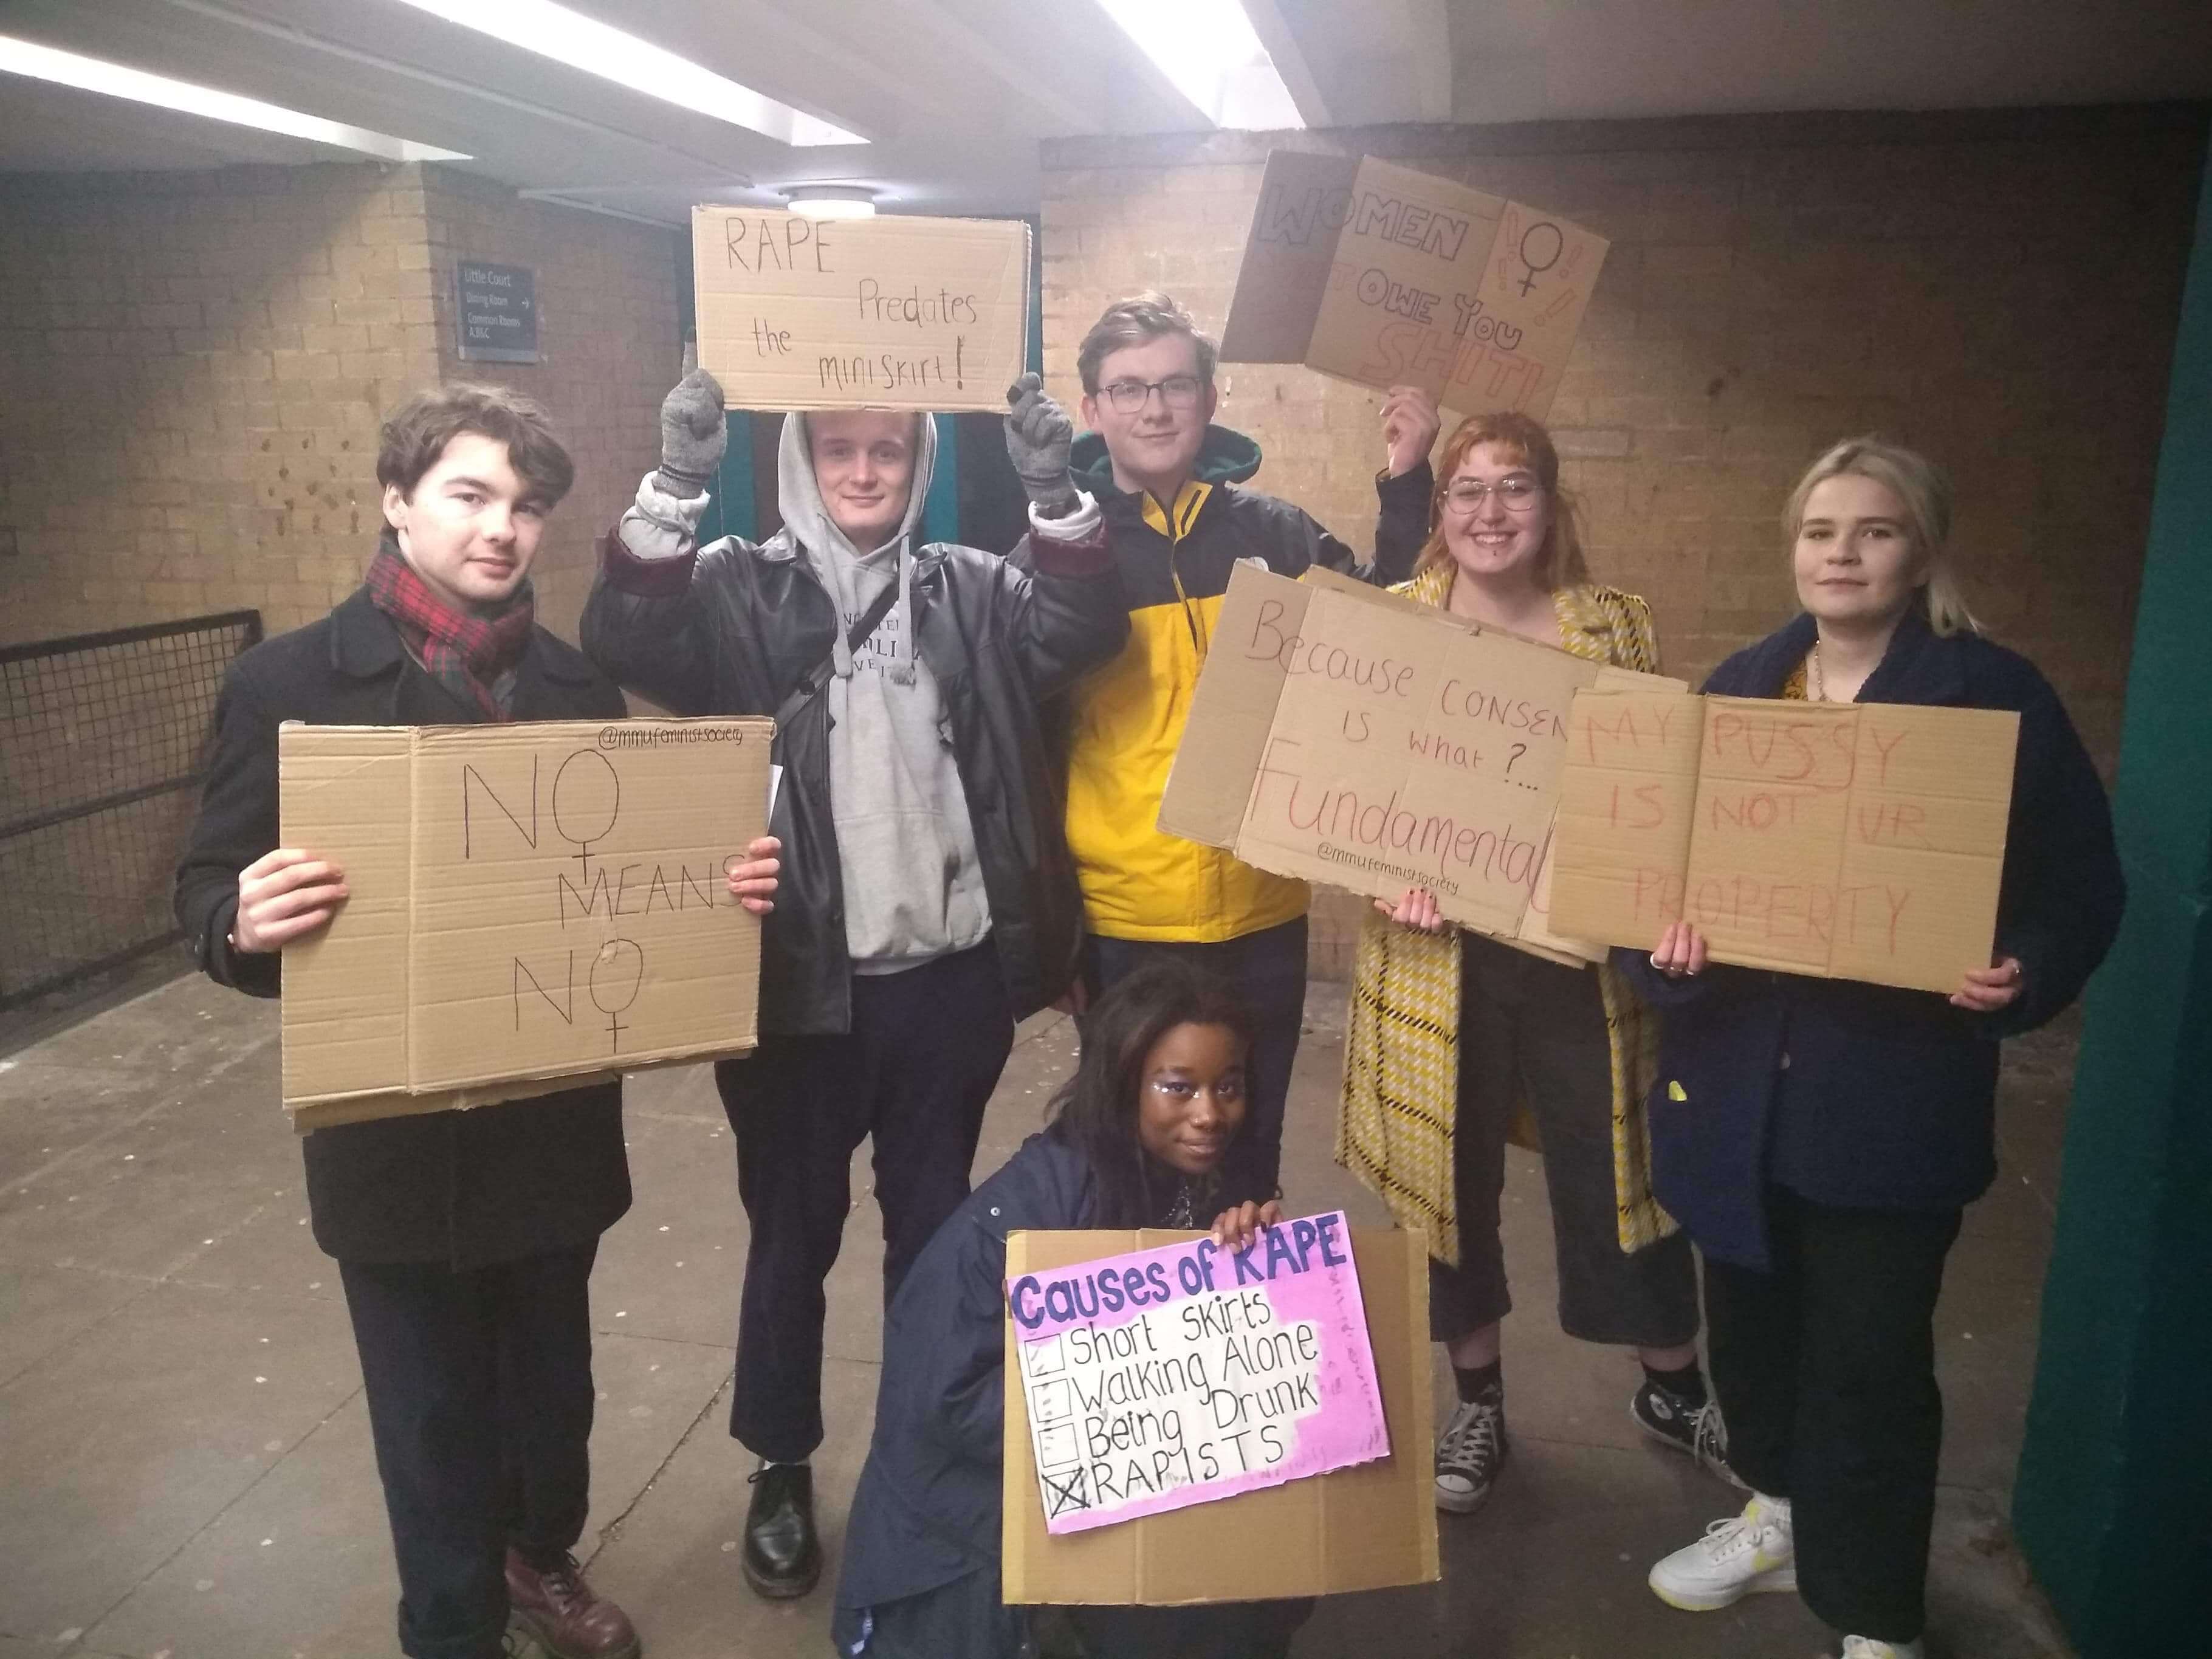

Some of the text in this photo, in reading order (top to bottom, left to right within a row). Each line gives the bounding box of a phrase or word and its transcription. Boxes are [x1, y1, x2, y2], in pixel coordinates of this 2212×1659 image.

[726, 217, 836, 273] RAPE
[1258, 184, 1469, 261] WOMEN
[464, 268, 511, 287] Little Court
[466, 292, 508, 307] Dining Room
[859, 278, 977, 328] Predates
[1356, 267, 1441, 325] OWE
[1454, 292, 1522, 351] YOU
[467, 311, 520, 328] Common Rooms
[751, 317, 791, 357] the
[1245, 600, 1568, 743] Because CONSEN
[1342, 710, 1370, 743] IS
[1587, 704, 1909, 793] MY PUSSY
[464, 749, 620, 859] NO
[1251, 738, 1556, 914] Fundamental
[1610, 784, 1934, 851] IS NOT UR
[558, 854, 745, 930] MEANS
[1633, 867, 1911, 955] PROPERTY
[515, 938, 644, 1032] NO
[1011, 1261, 1172, 1331] Causes
[1178, 1238, 1217, 1295] of
[1070, 1314, 1157, 1365] Short
[1072, 1323, 1317, 1413] Walking Alone
[1086, 1372, 1319, 1459] Being Drunk
[1092, 1426, 1284, 1505] RAPISTS
